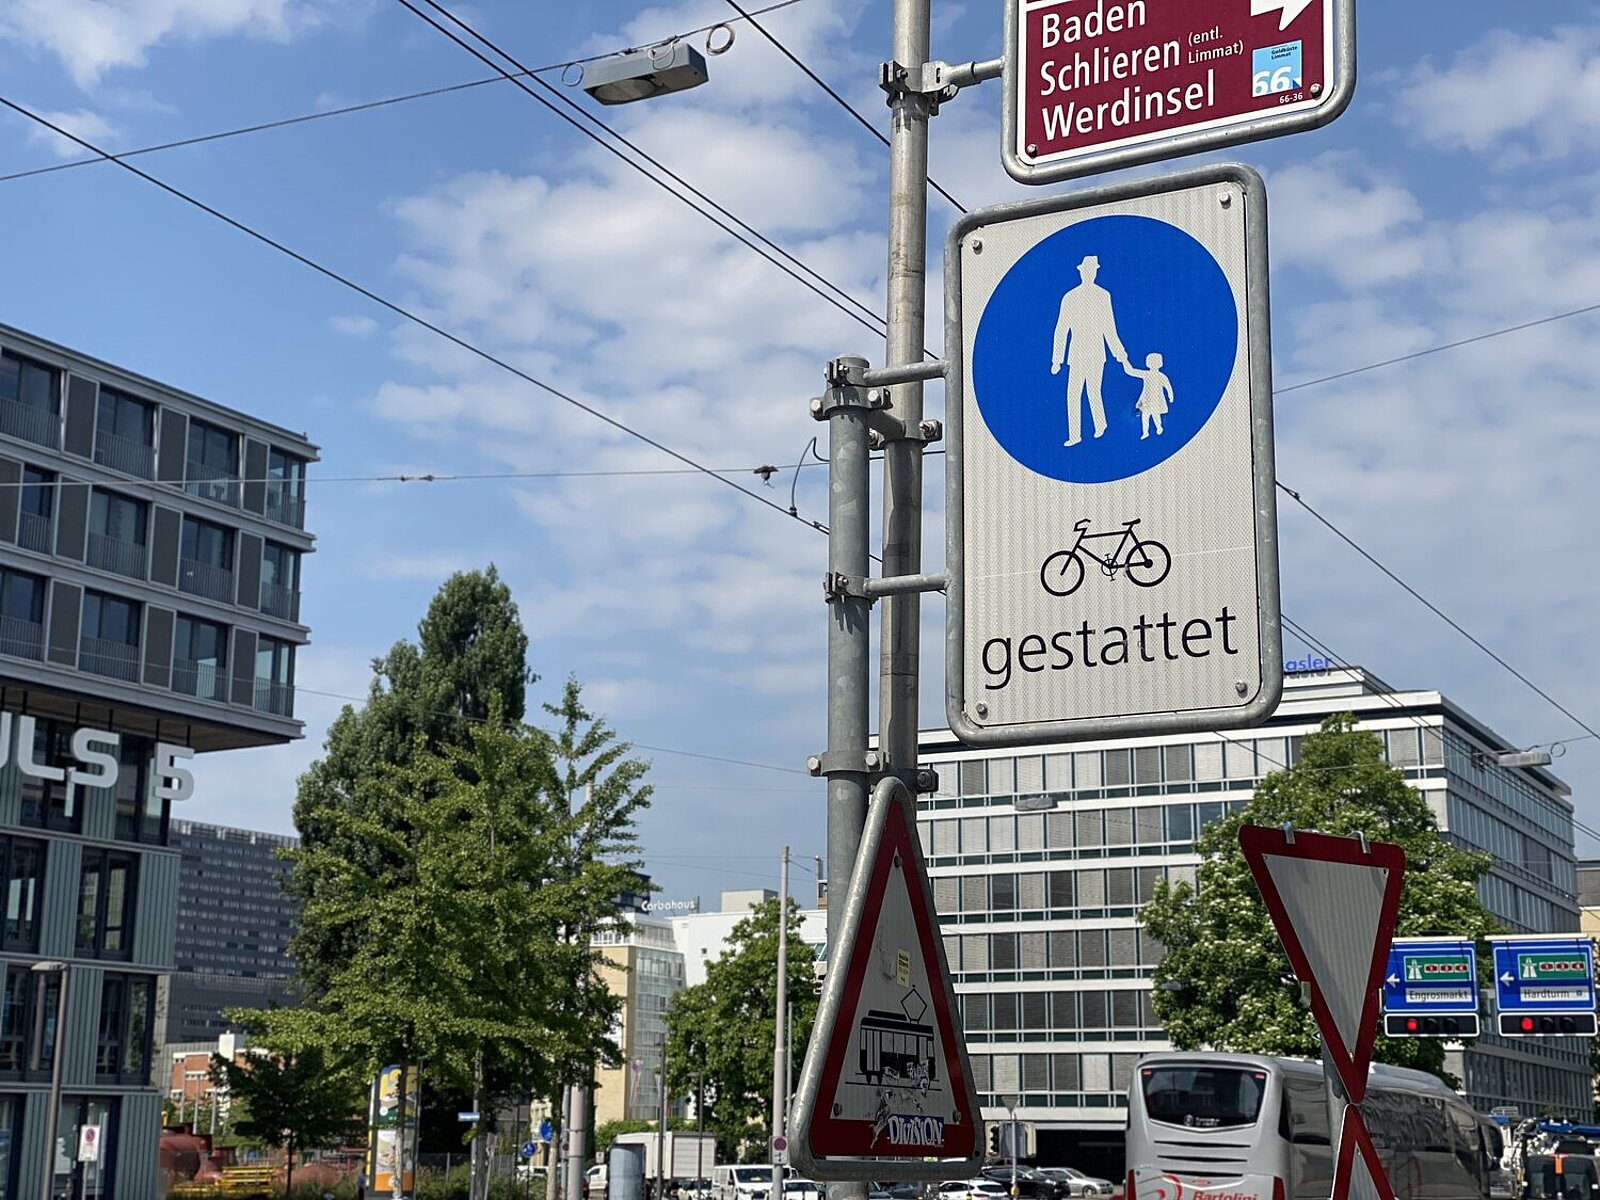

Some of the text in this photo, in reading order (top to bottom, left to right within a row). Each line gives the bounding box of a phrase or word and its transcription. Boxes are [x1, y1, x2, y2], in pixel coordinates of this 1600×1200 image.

[1042, 0, 1146, 48] Baden
[1188, 25, 1223, 47] (entl.
[1188, 40, 1244, 64] Limmat)
[1040, 40, 1180, 97] Schlieren
[1252, 66, 1293, 97] 66
[1041, 69, 1215, 141] Werdinsel
[1279, 92, 1303, 104] 66-36
[982, 606, 1238, 690] gestattet
[0, 711, 195, 801] LS 5
[1409, 990, 1468, 1002] Engrosmarkt
[1524, 989, 1570, 999] Hardturm
